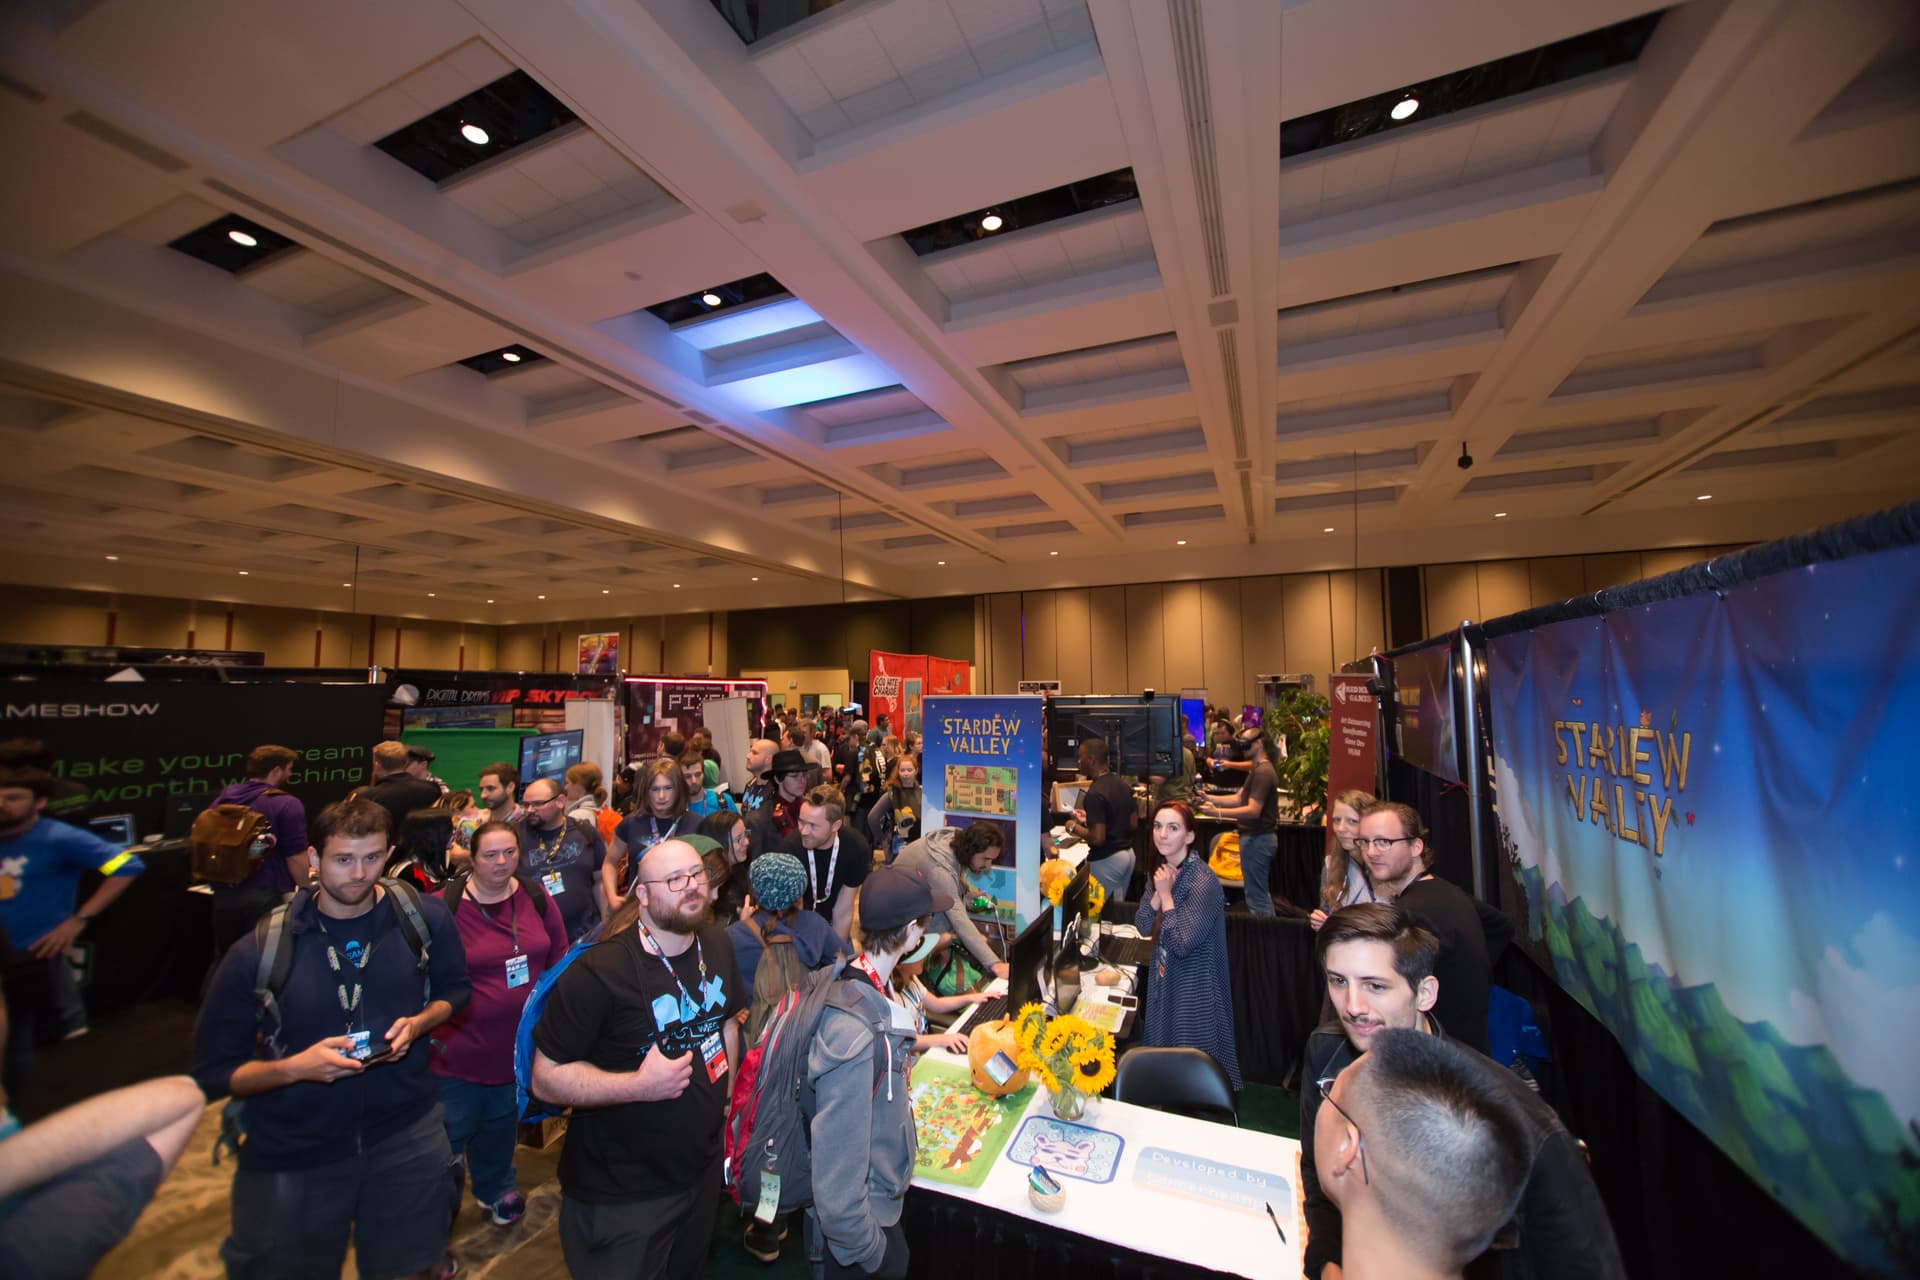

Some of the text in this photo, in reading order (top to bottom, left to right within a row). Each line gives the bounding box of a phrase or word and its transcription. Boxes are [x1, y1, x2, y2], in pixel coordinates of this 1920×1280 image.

[523, 689, 600, 704] SKYBO
[0, 702, 161, 719] MESHOW
[943, 717, 1021, 737] STARDEW
[949, 736, 1011, 756] VALLEY
[159, 752, 244, 776] your
[296, 744, 365, 761] ream
[92, 777, 209, 802] worth
[652, 974, 727, 1033] PAX
[1152, 1151, 1266, 1188] Developed by
